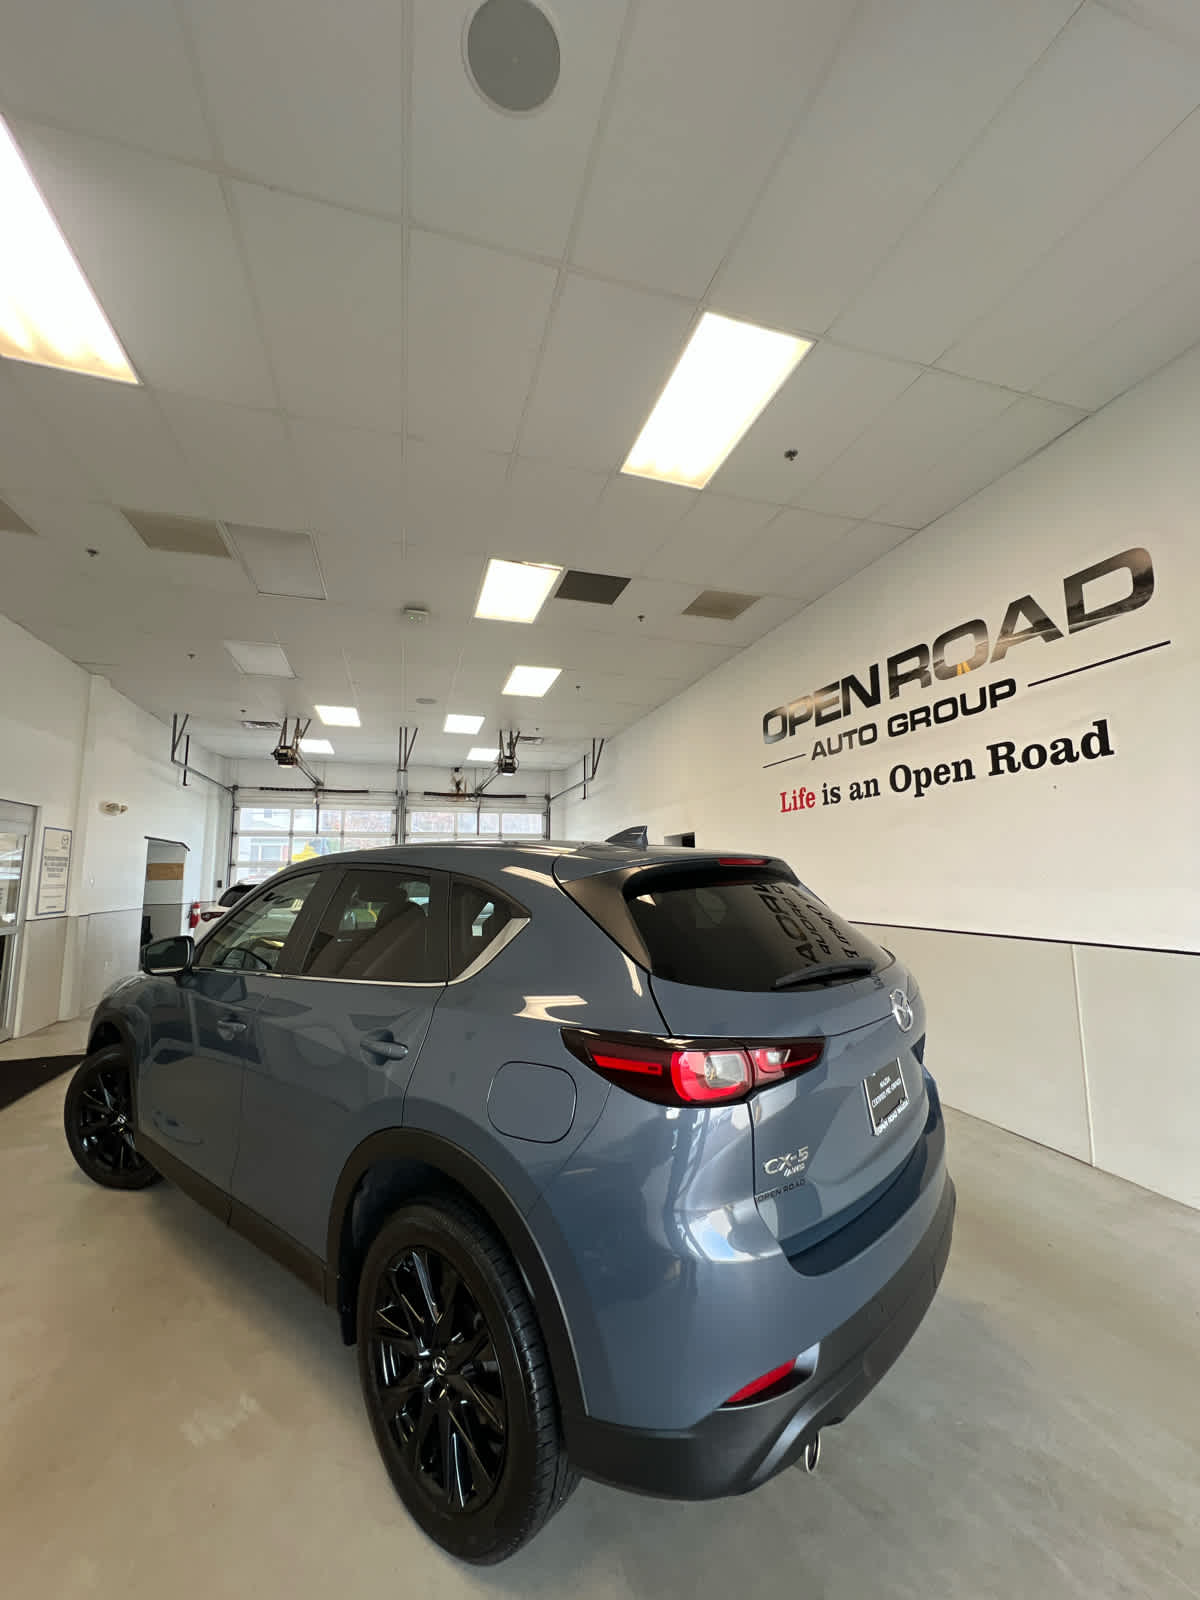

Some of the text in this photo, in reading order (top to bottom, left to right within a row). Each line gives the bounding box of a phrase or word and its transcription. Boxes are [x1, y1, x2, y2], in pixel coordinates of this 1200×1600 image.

[811, 678, 1016, 760] AUTO GROUP
[779, 719, 1114, 813] Life is an Open Road
[764, 1146, 808, 1174] CX-5
